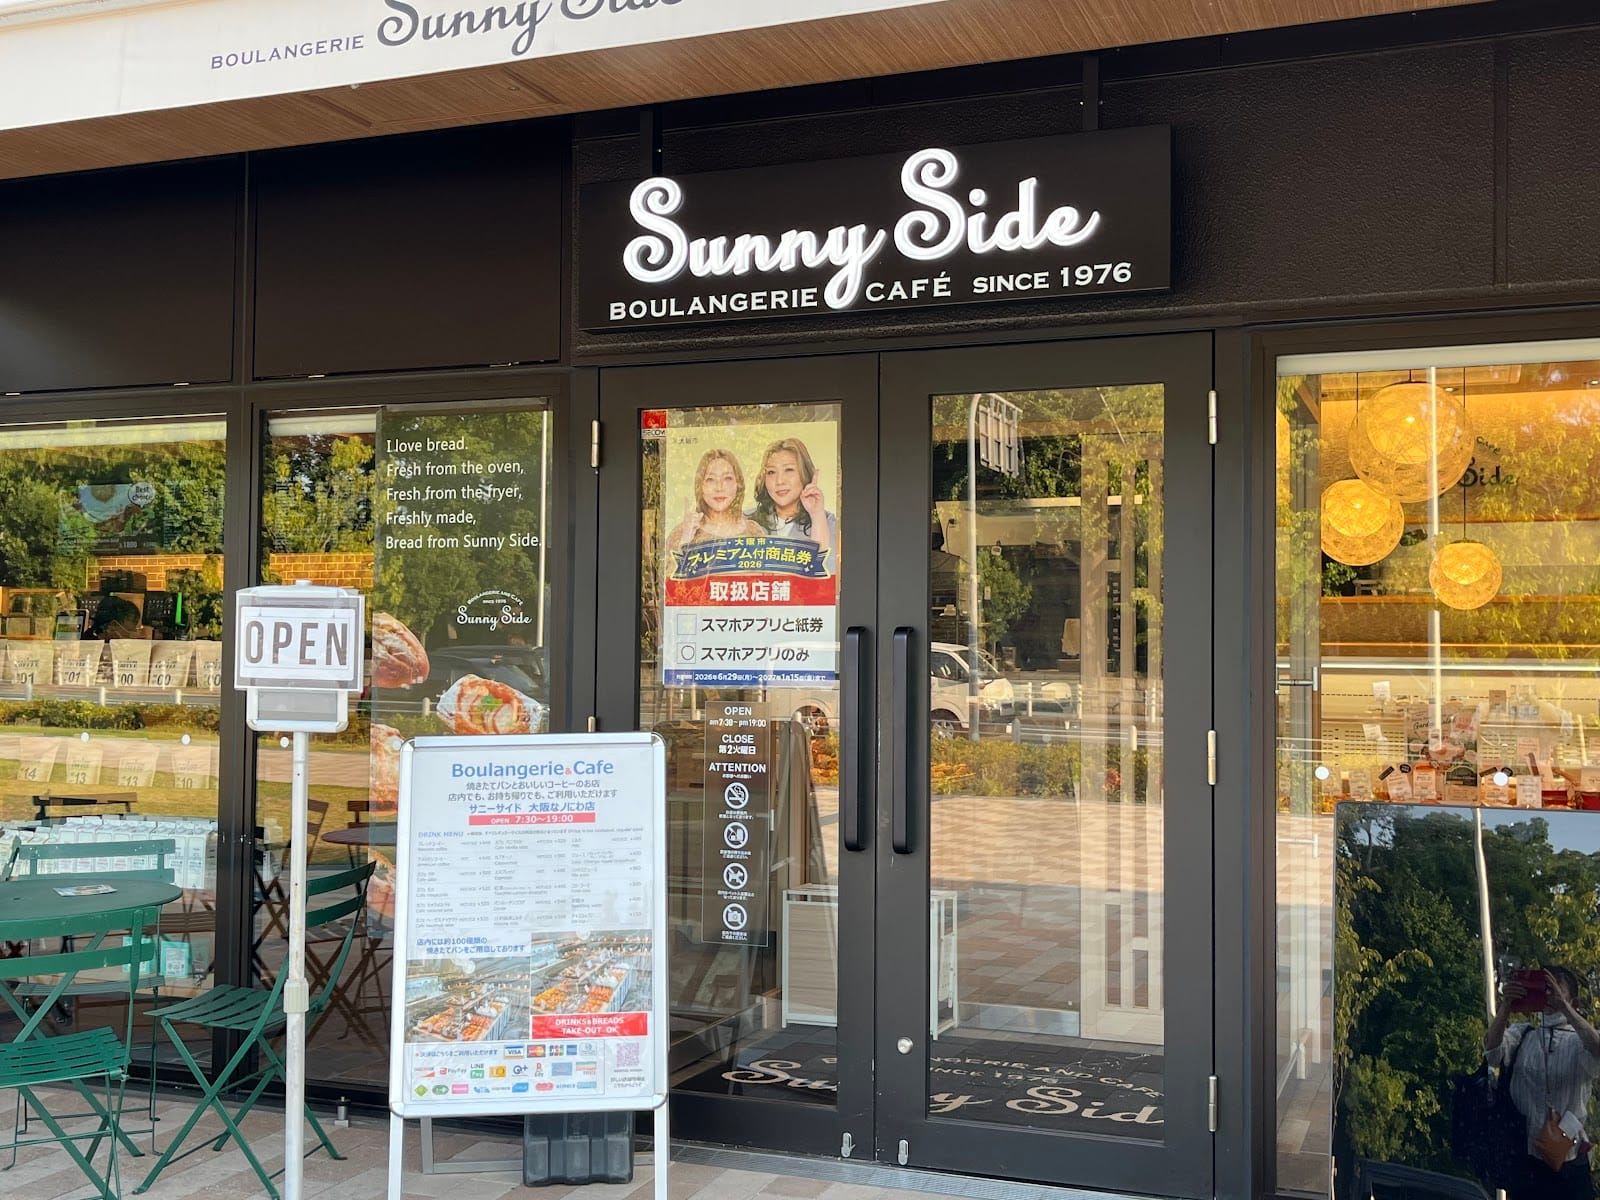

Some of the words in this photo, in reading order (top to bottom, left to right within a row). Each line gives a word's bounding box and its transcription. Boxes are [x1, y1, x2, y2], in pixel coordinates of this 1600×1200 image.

[210, 35, 365, 70] BOULANGERIE
[623, 176, 886, 310] Sunny
[893, 147, 1100, 261] Side
[608, 287, 819, 321] BOULANGERIE
[865, 271, 953, 302] CAFÉ
[972, 271, 1050, 295] SINCE
[1060, 262, 1133, 288] 1976
[395, 439, 423, 453] love
[427, 437, 469, 452] bread.
[386, 463, 421, 477] Fresh
[426, 462, 457, 475] from
[462, 461, 484, 474] the
[488, 462, 524, 475] oven,
[386, 487, 421, 501] Fresh
[425, 486, 457, 500] from
[461, 485, 483, 498] the
[487, 484, 523, 501] fryer,
[386, 511, 432, 527] Freshly
[436, 510, 477, 525] made,
[386, 535, 423, 549] Bread
[427, 535, 459, 549] from
[464, 535, 505, 551] Sunny
[509, 533, 542, 547] Side.
[688, 546, 813, 567] プレミアム付商品券
[738, 560, 763, 569] 2026
[709, 580, 791, 602] 取扱店舗
[457, 604, 500, 632] Sunny
[501, 604, 533, 624] Side
[701, 617, 824, 633] スマホアプリと紙券
[245, 620, 348, 666] OPEN
[700, 645, 810, 662] スマホアプリのみ
[724, 706, 752, 716] OPEN
[721, 734, 755, 744] CLOSE
[708, 762, 767, 773] ATTENTION
[469, 803, 522, 814] サニーサイド
[490, 817, 510, 825] OPEN
[1033, 1065, 1093, 1079] AND
[1006, 1085, 1165, 1124] Sid
